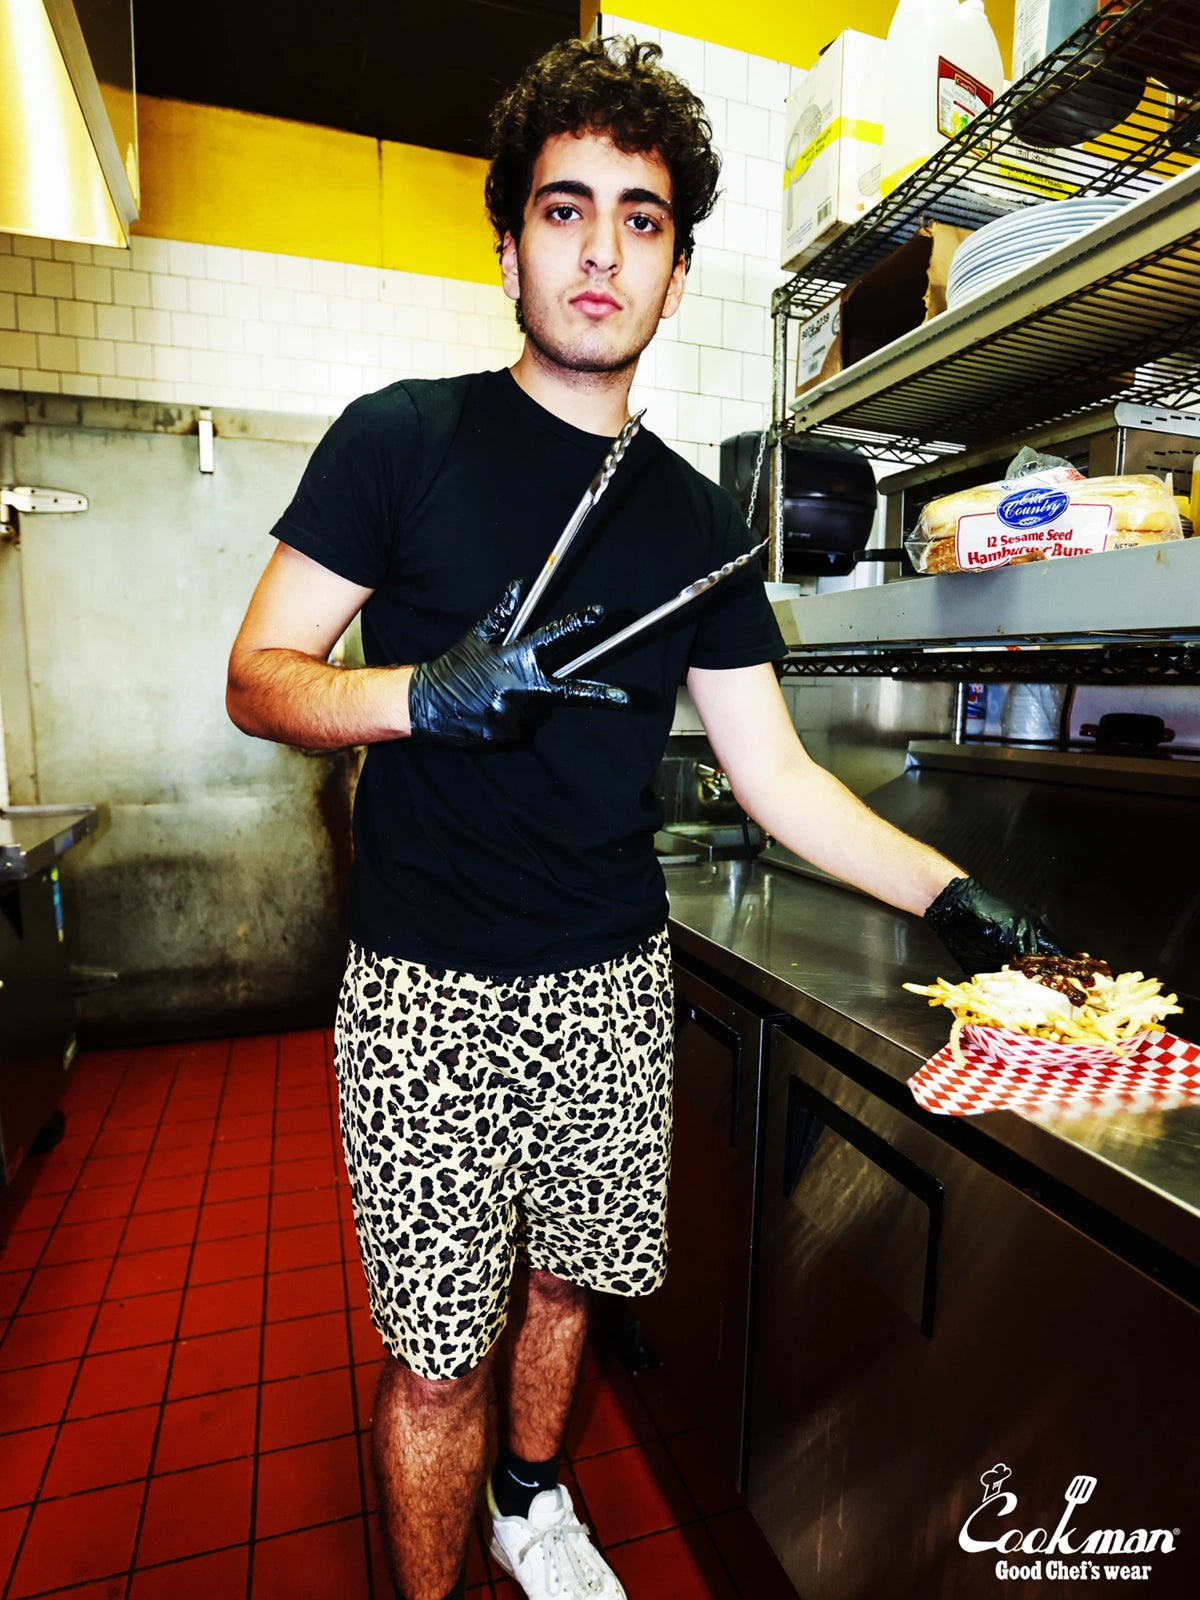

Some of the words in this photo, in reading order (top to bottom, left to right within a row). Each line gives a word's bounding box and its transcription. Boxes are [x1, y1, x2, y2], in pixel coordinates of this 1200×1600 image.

[1002, 499, 1061, 519] Country
[987, 536, 998, 548] 12
[1000, 531, 1045, 546] Sesame
[1046, 529, 1073, 542] Seed
